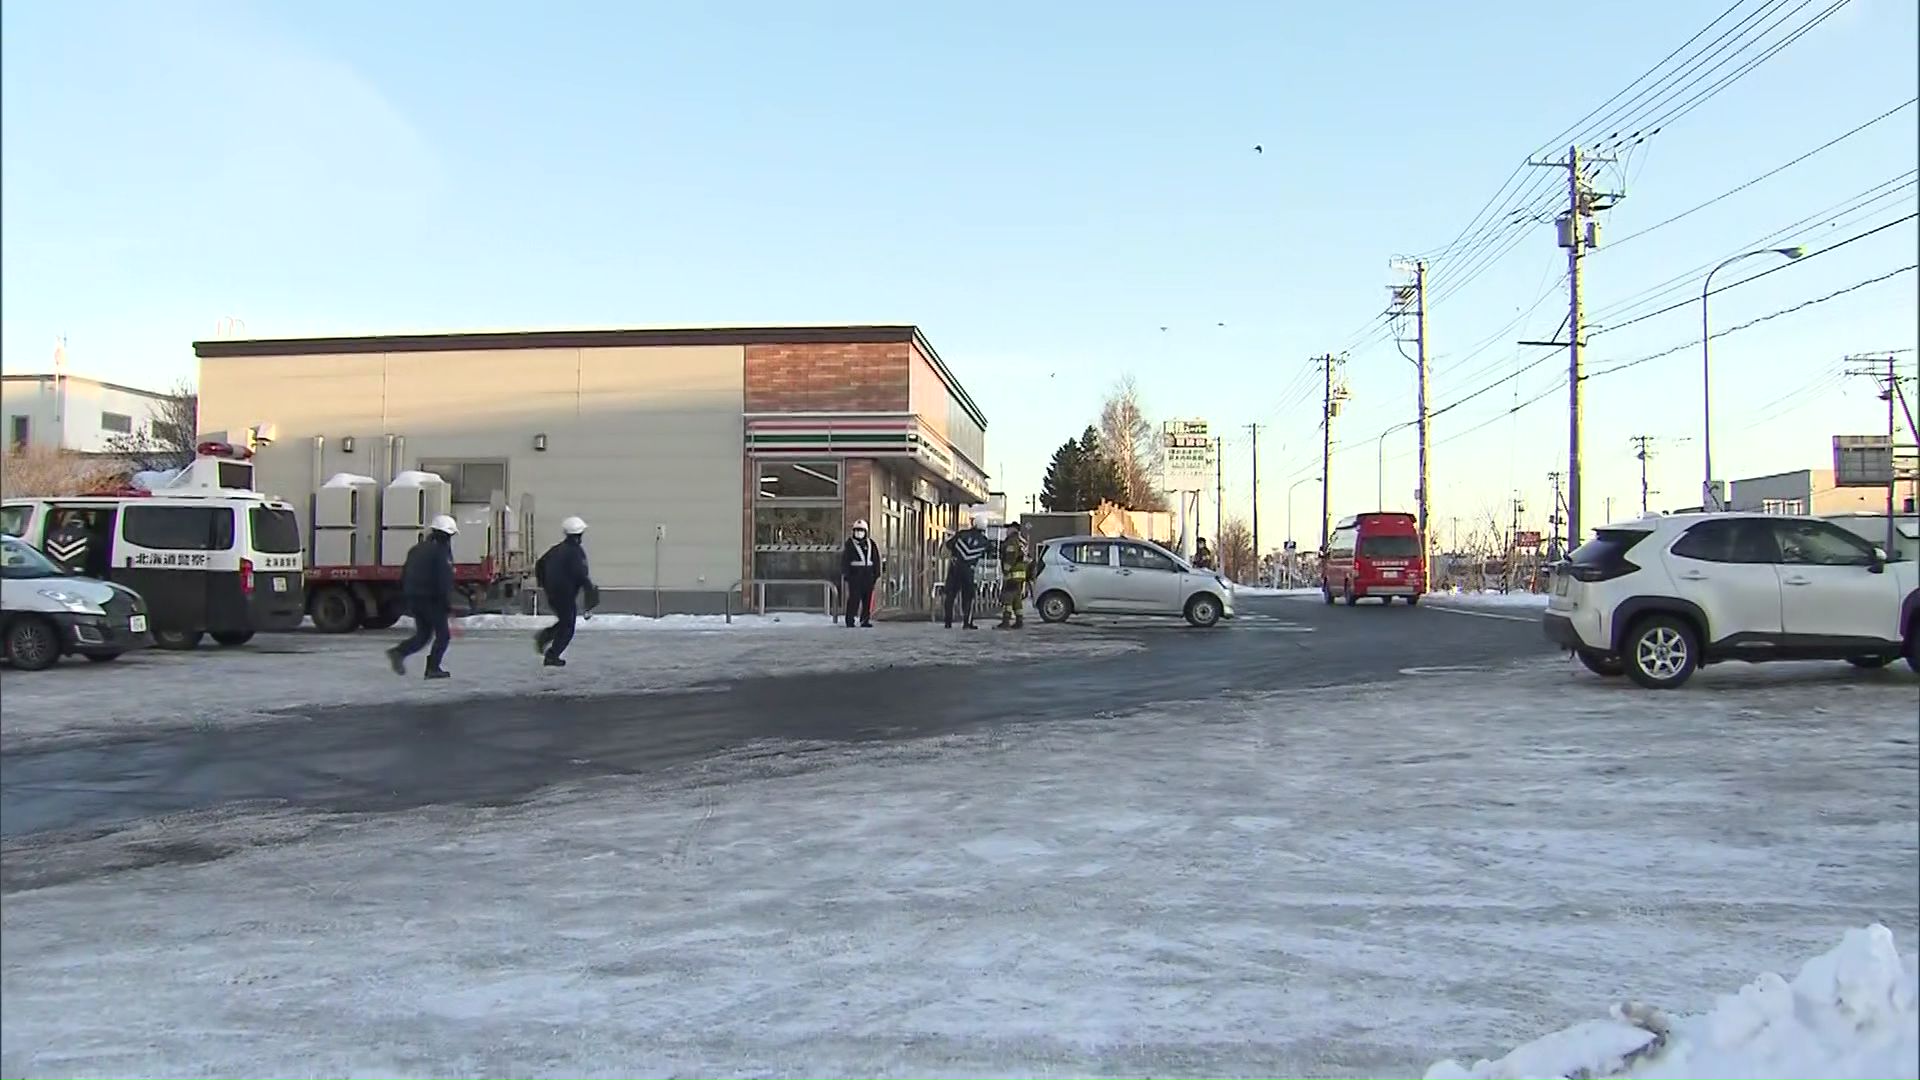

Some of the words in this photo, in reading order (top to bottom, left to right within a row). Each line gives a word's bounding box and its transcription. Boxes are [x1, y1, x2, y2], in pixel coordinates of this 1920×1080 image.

[135, 552, 205, 566] 北海道警察
